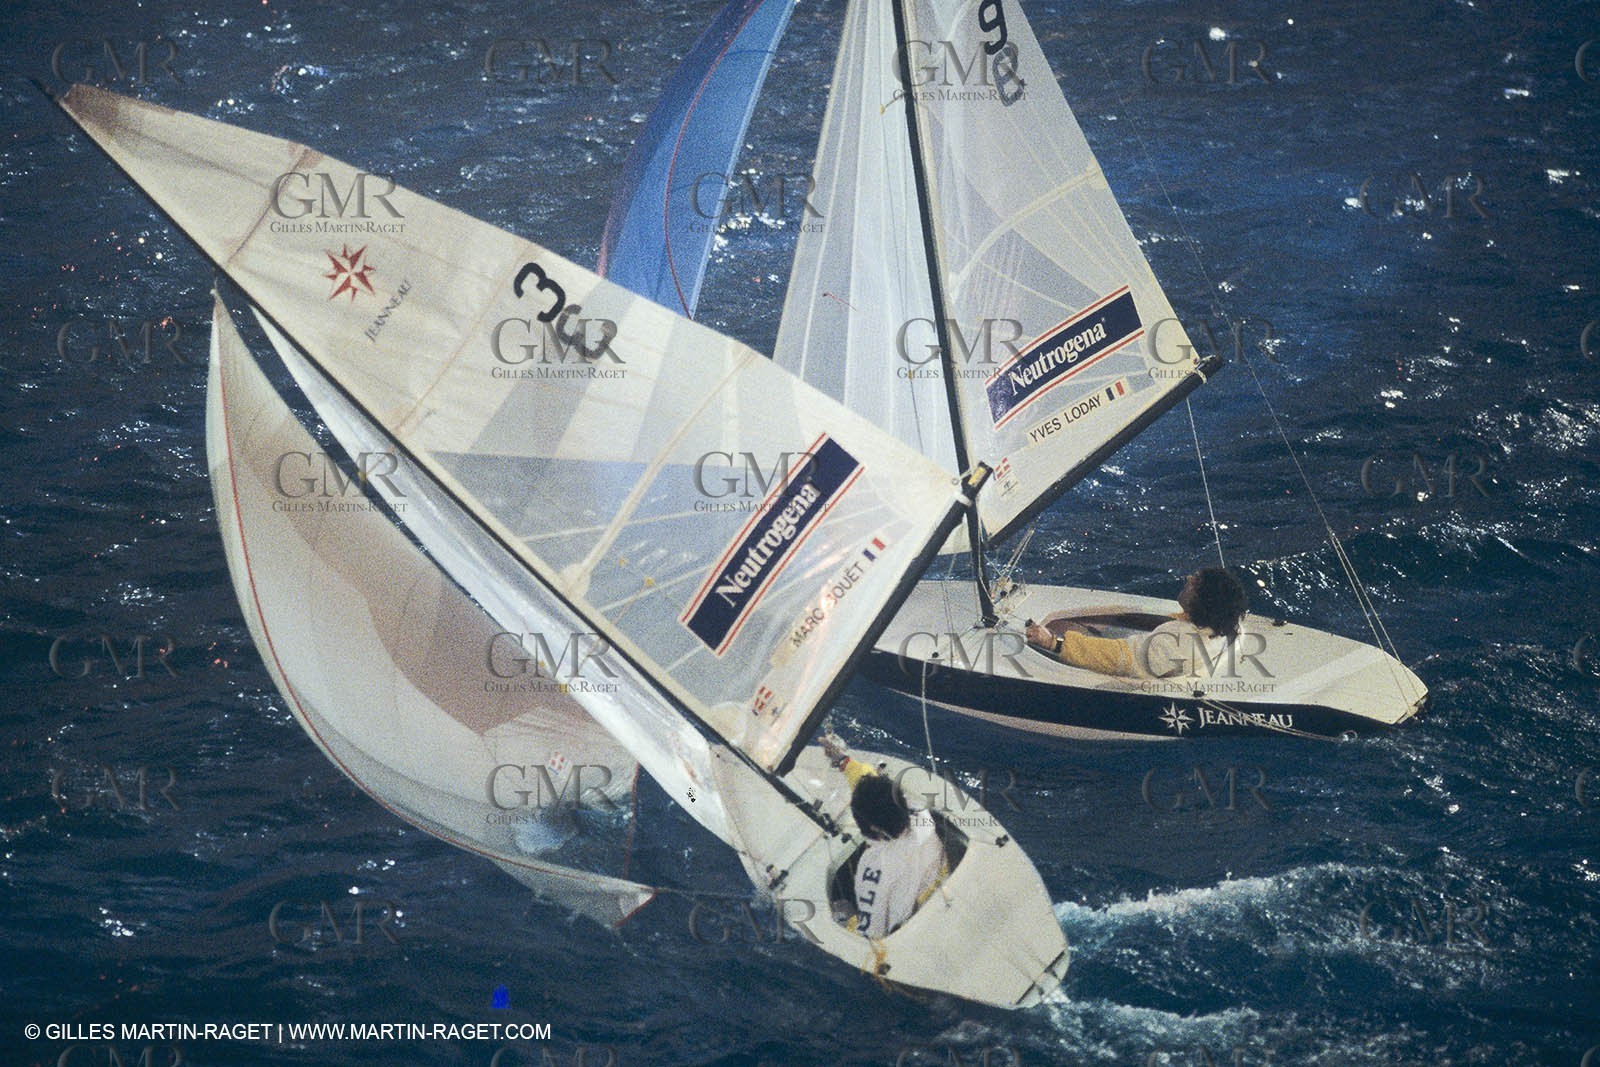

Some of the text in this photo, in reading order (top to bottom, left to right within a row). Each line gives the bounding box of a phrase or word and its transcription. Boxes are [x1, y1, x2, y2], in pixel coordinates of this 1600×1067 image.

[978, 0, 1008, 56] 9
[364, 279, 413, 343] JEANNEAU
[513, 262, 567, 323] 3
[1007, 322, 1107, 397] Neutrogena
[1030, 395, 1103, 443] YVES LODAY
[715, 483, 821, 608] Neutrogena
[790, 607, 825, 648] MARC
[1197, 706, 1293, 729] JEANNEAU
